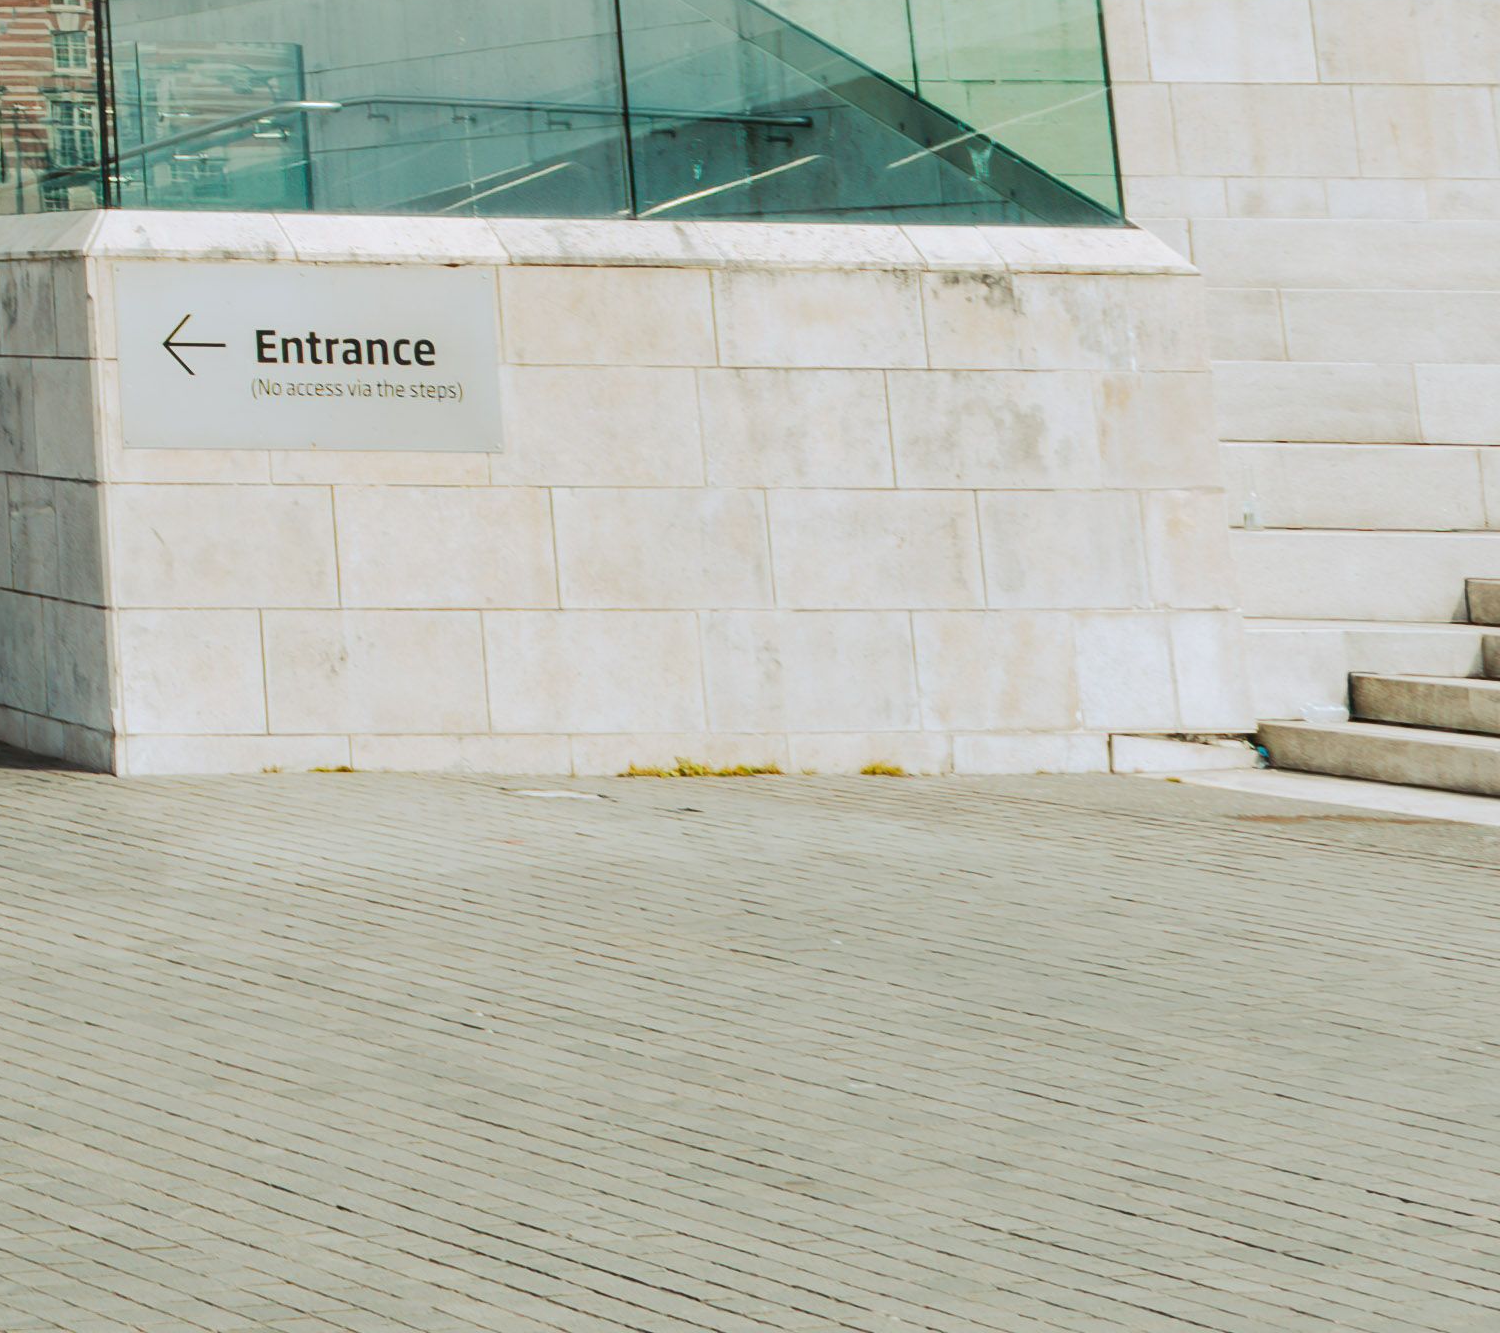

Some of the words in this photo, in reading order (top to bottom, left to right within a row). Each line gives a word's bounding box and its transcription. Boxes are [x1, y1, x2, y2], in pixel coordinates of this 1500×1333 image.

[255, 329, 436, 366] Entrance
[251, 378, 282, 400] (No
[286, 382, 343, 397] access
[347, 379, 372, 397] via
[376, 380, 405, 397] the
[409, 382, 464, 402] steps)
